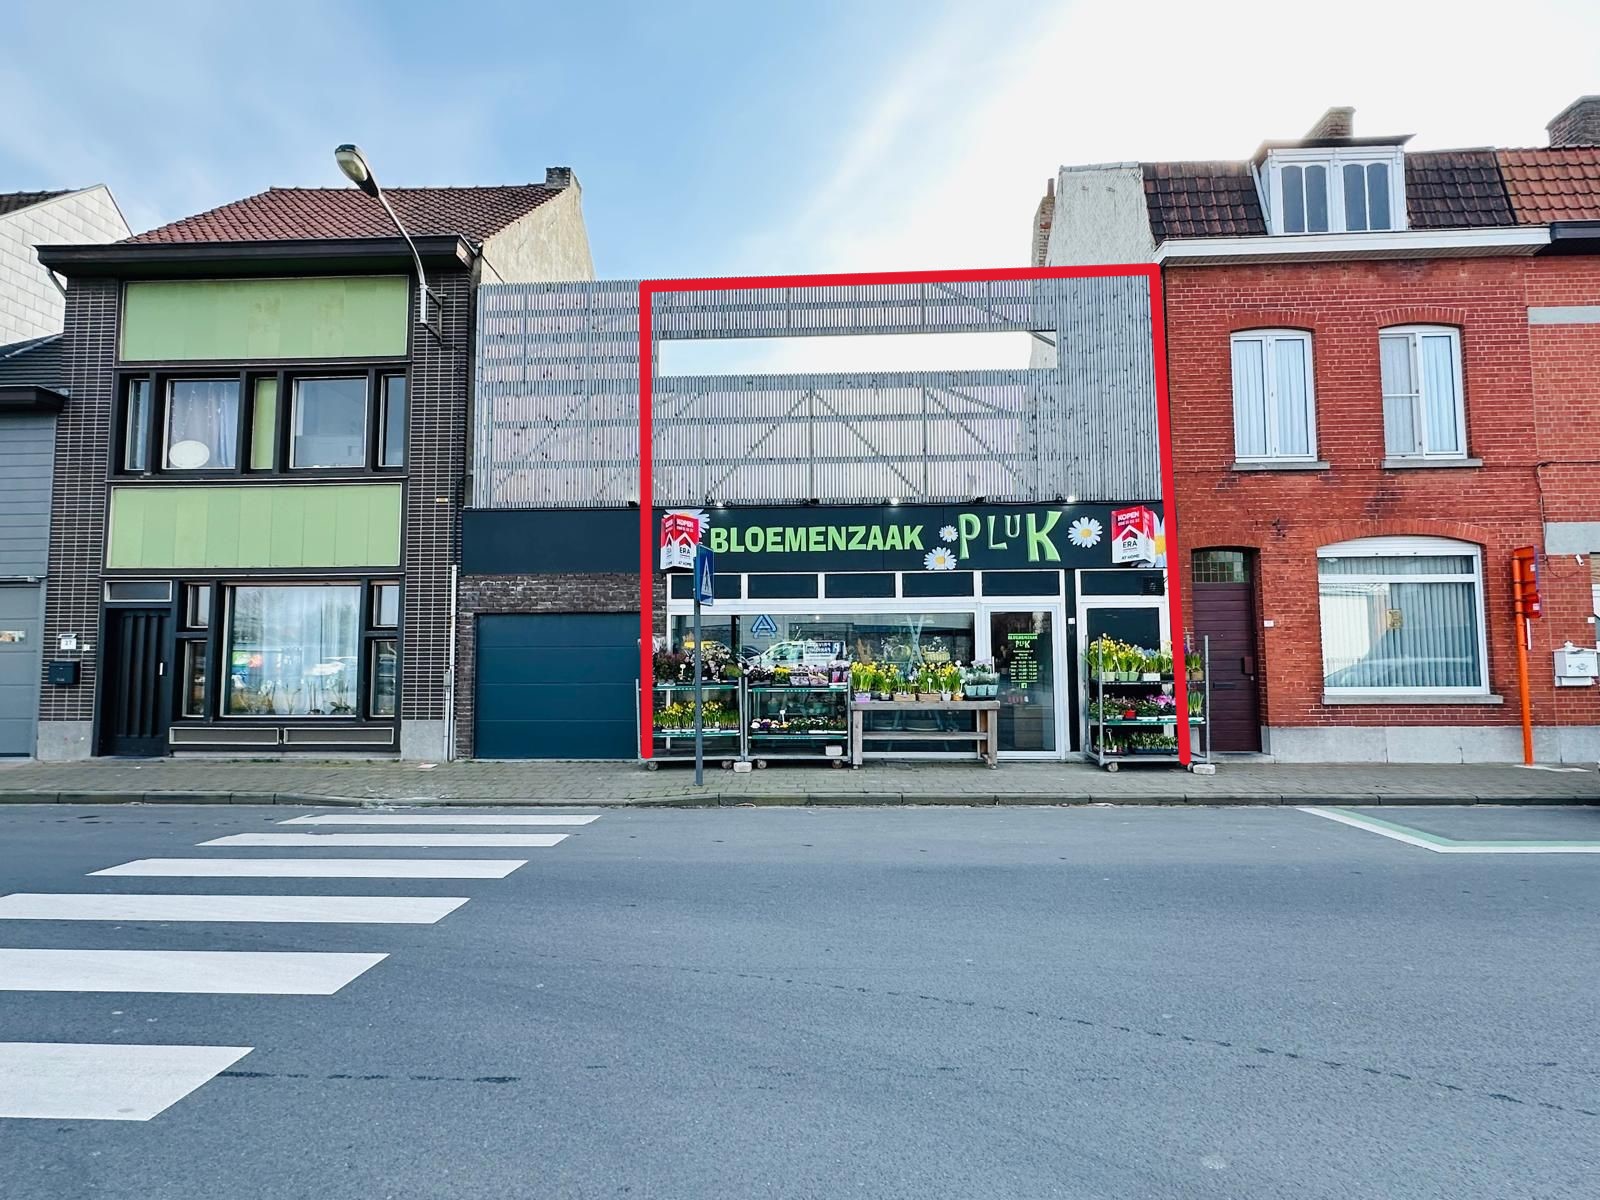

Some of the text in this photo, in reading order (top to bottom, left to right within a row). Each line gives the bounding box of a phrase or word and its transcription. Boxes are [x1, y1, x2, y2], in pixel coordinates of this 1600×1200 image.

[1117, 511, 1140, 521] KOPEN
[710, 511, 1062, 562] BLOEMENZAAK PLUK
[1122, 540, 1138, 548] ERA
[1015, 640, 1031, 649] PLUK
